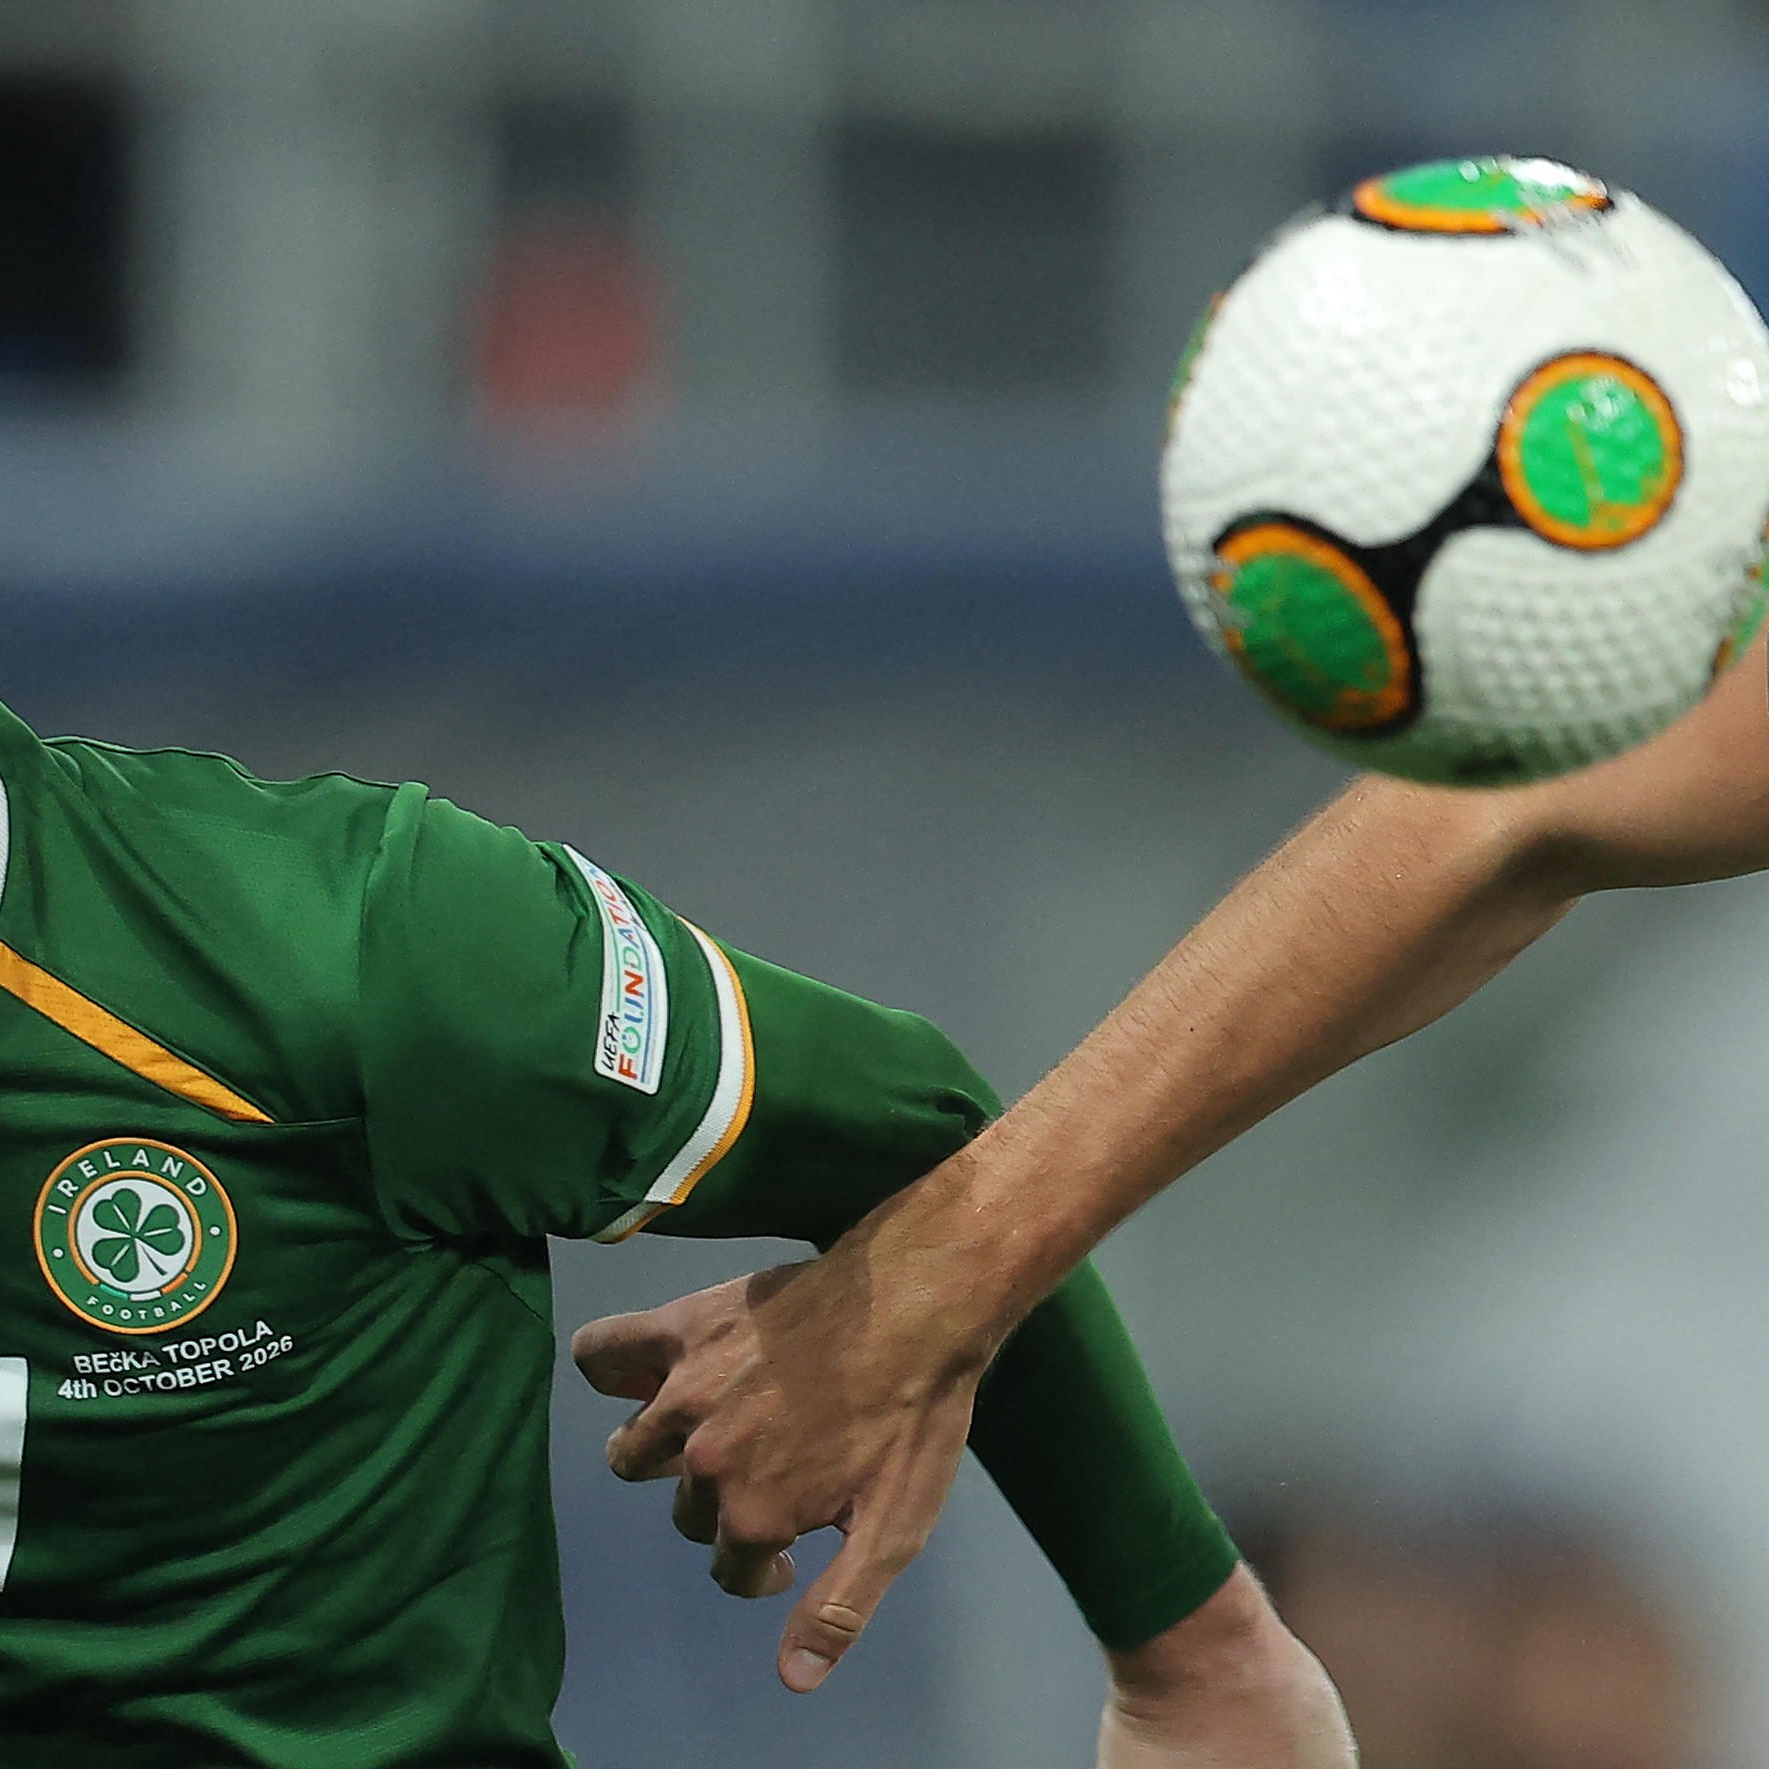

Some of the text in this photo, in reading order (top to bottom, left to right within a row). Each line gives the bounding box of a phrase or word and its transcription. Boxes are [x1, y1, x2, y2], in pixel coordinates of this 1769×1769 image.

[601, 1011, 620, 1071] UEFA
[48, 1149, 207, 1214] IRELAND
[86, 1281, 208, 1320] FOOTBALL
[58, 1335, 294, 1399] 4th OCTOBER 2026
[162, 1320, 273, 1364] TOPOLA
